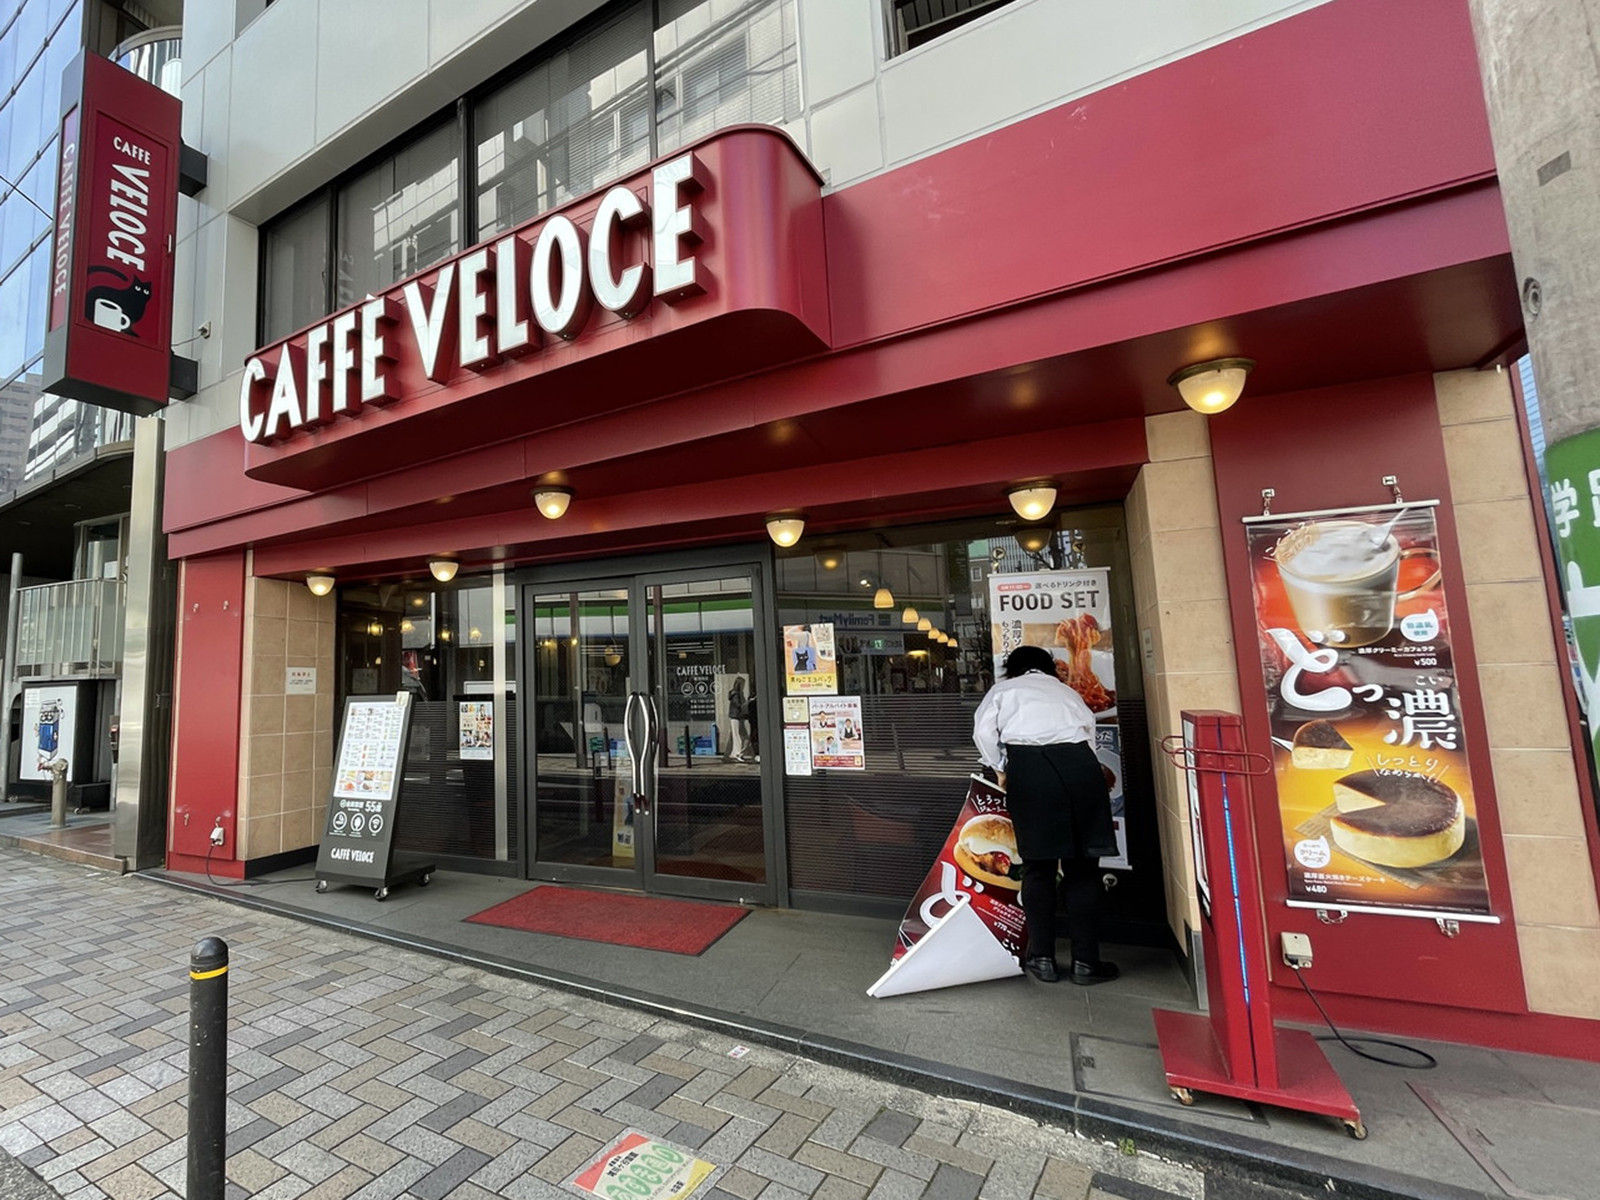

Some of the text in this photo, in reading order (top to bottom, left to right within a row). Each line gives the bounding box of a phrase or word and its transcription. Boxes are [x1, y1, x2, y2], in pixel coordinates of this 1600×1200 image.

[106, 136, 151, 272] CAFFE VELOCE
[54, 211, 71, 297] VELOCE
[404, 152, 693, 382] VELOCE
[1035, 579, 1097, 589] 選べるドリンク付き
[1000, 590, 1099, 612] FOOD SET
[699, 664, 726, 675] VELOCE
[1416, 675, 1444, 686] こい
[1377, 753, 1438, 773] しっとり
[351, 849, 374, 863] VELOCE
[1002, 938, 1020, 951] こい
